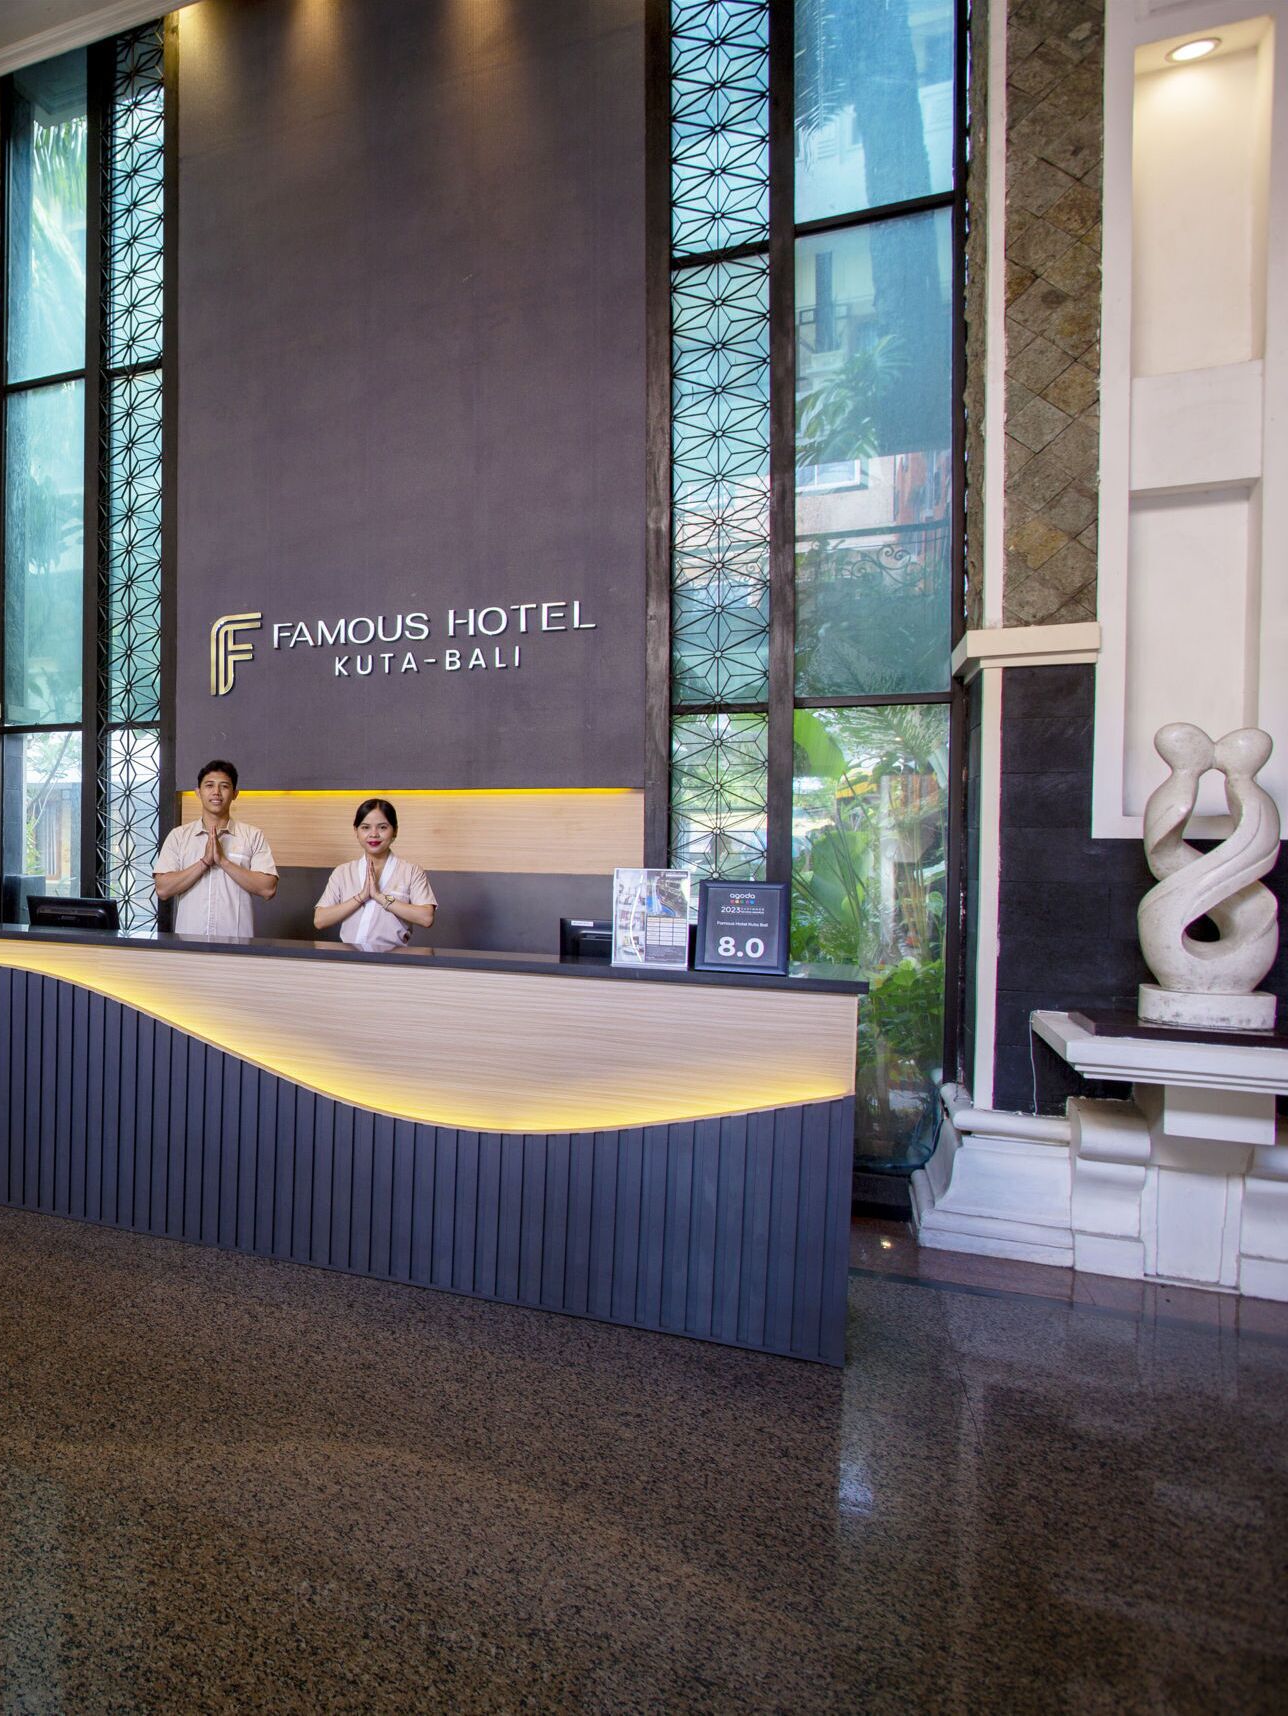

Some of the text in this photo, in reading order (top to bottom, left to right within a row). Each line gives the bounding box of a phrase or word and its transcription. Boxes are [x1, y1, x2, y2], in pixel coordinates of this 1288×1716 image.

[272, 600, 597, 649] FAMOUS HOTEL
[334, 646, 522, 677] KUTA-BALI
[729, 892, 756, 900] agoda
[720, 906, 741, 914] 2023
[717, 936, 765, 958] 8.0
